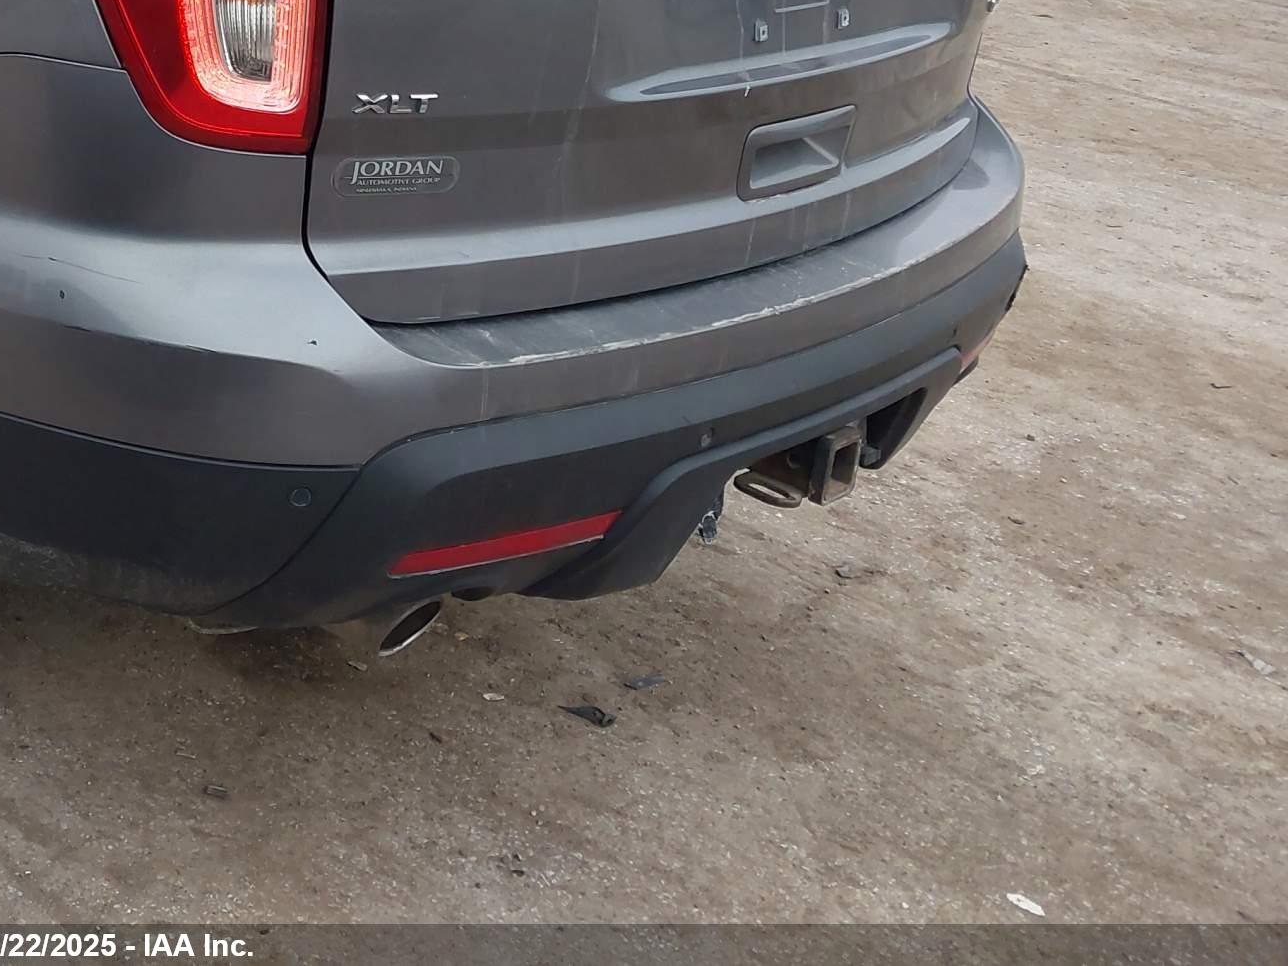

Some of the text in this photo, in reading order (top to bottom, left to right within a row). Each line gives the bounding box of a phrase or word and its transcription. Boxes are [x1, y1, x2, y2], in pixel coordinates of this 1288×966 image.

[352, 93, 439, 114] XLT
[350, 160, 444, 185] JORDAN
[357, 178, 410, 186] AUTOMOTIVE
